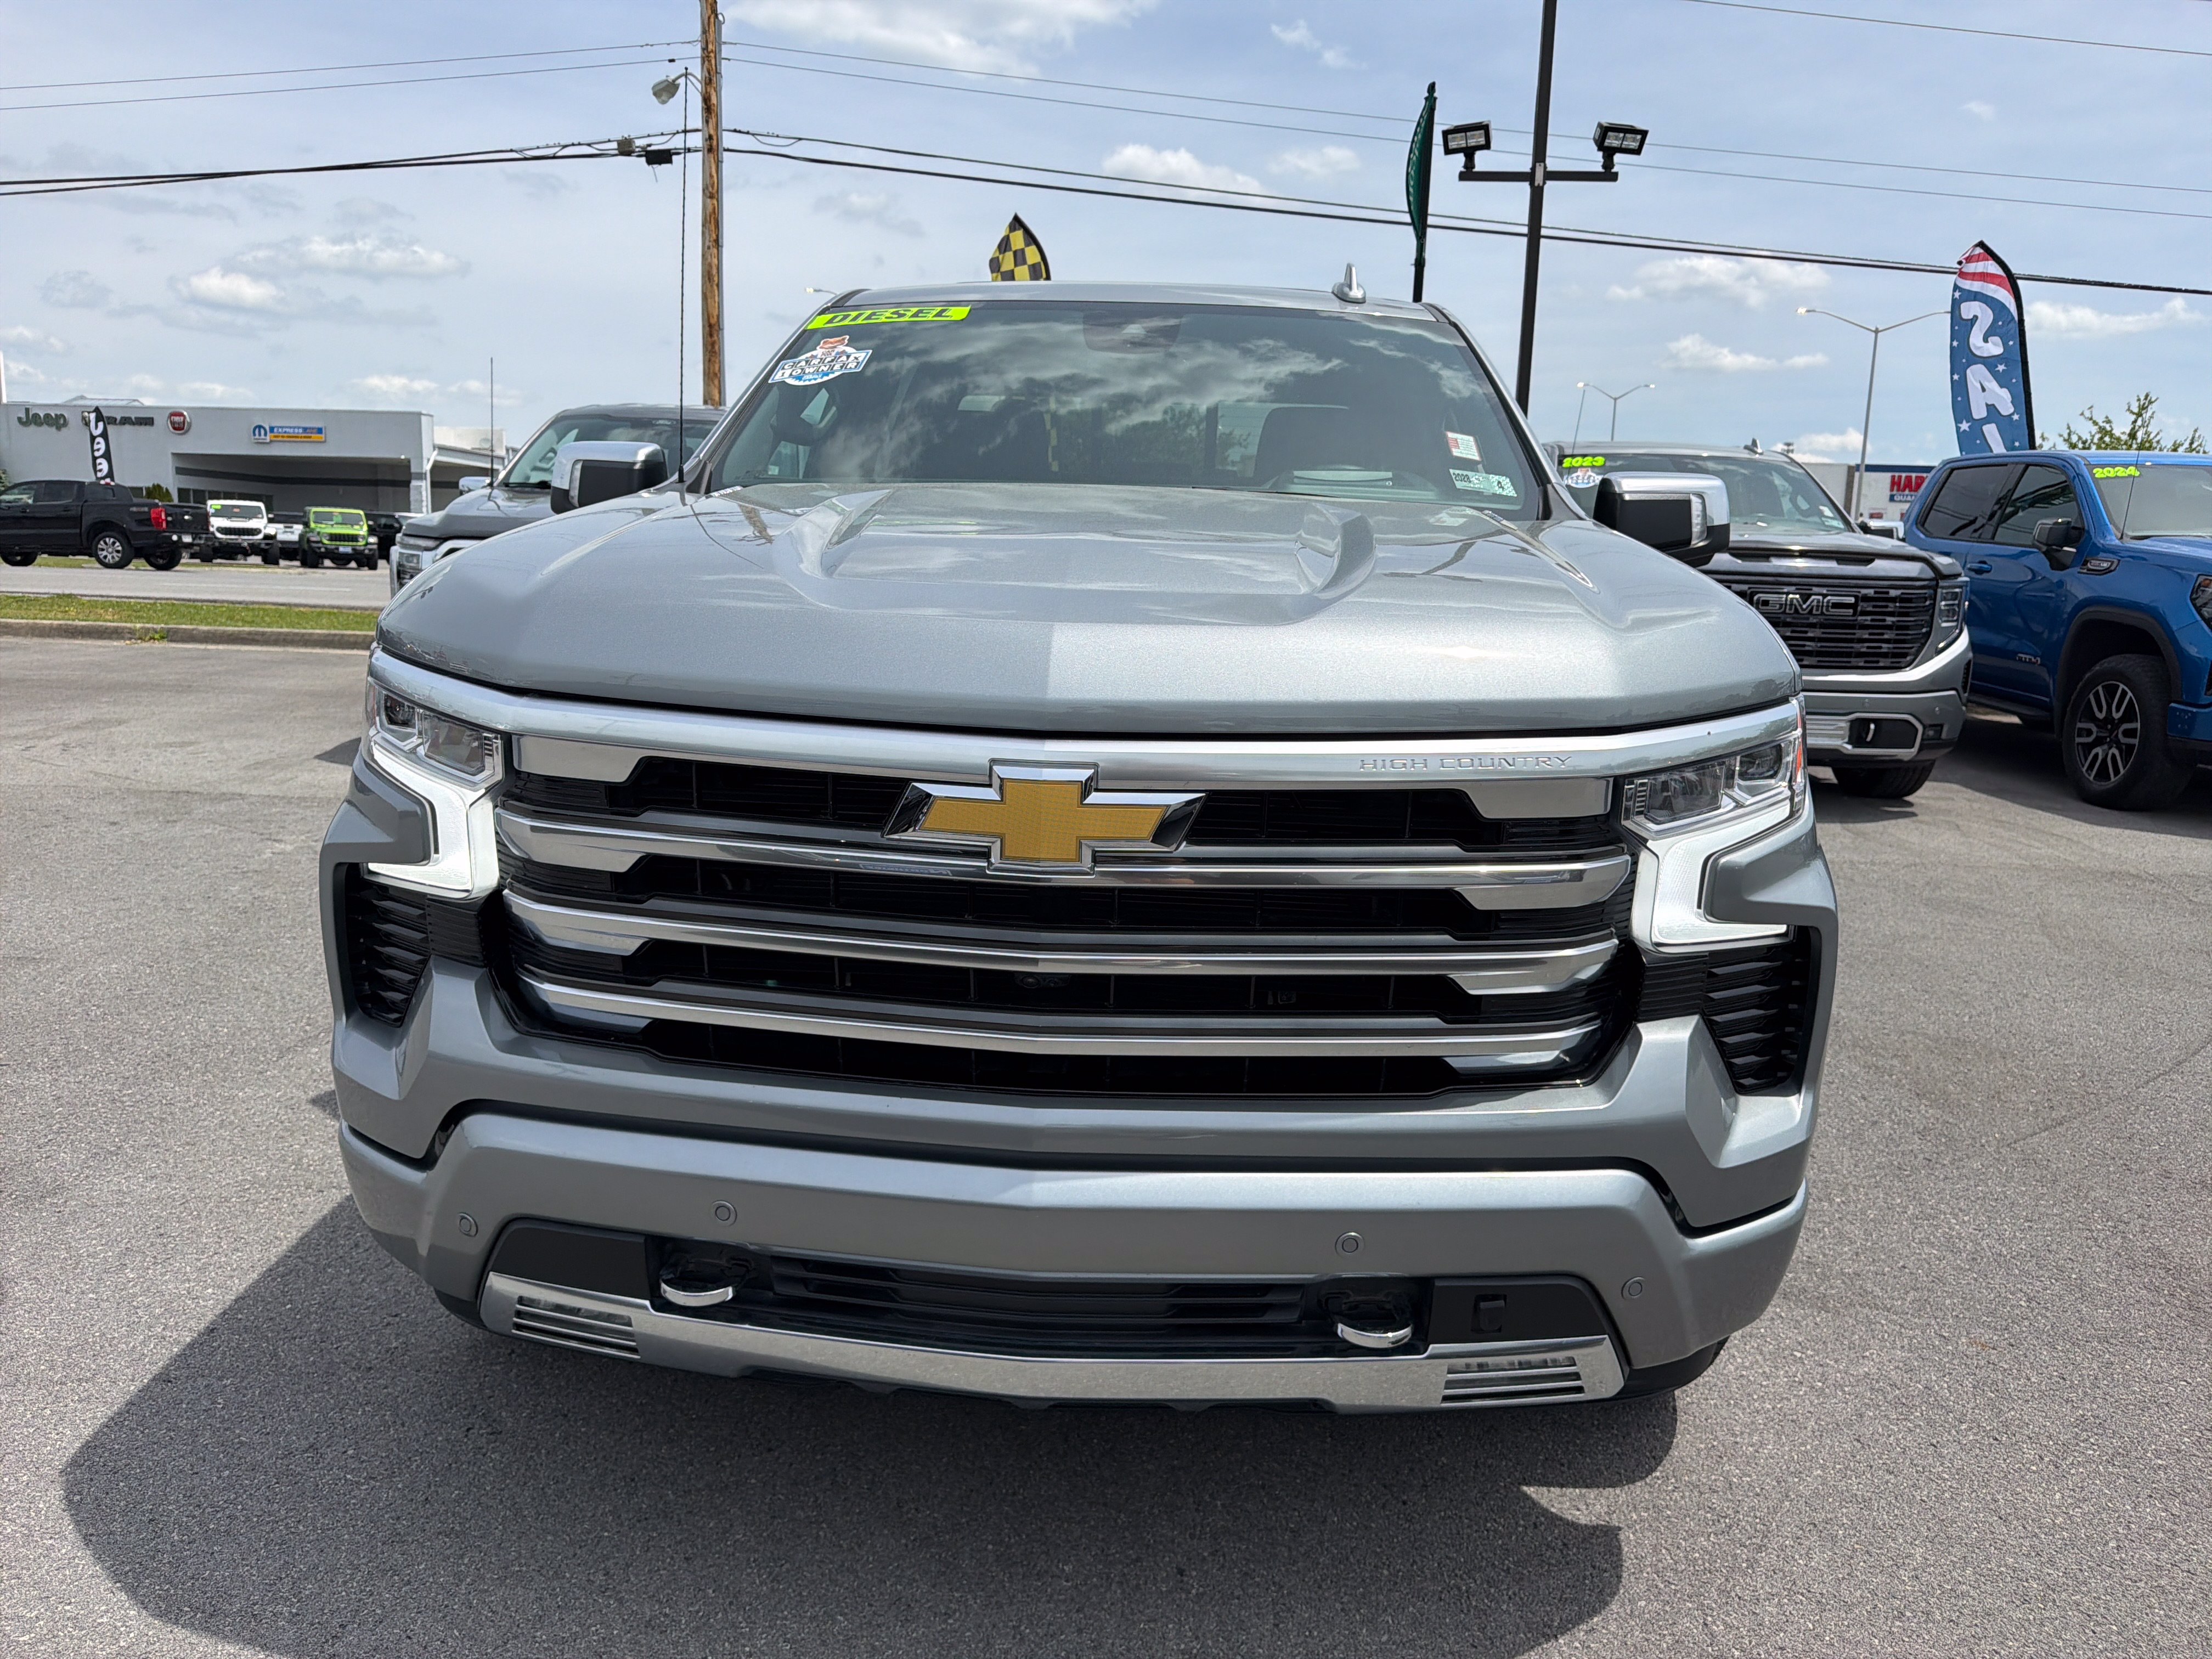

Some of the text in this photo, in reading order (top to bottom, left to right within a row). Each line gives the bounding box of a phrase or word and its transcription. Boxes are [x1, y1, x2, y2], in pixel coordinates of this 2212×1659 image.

[822, 308, 953, 326] DIESEL
[784, 355, 862, 370] CARFAX
[791, 363, 857, 376] OWNER
[17, 407, 154, 431] Jeep RAM
[1562, 456, 1605, 467] 2023
[1453, 472, 1471, 483] 2028
[2092, 466, 2140, 478] 2024
[1753, 594, 1855, 616] GMC
[1359, 756, 1572, 771] HIGH COUNTRY
